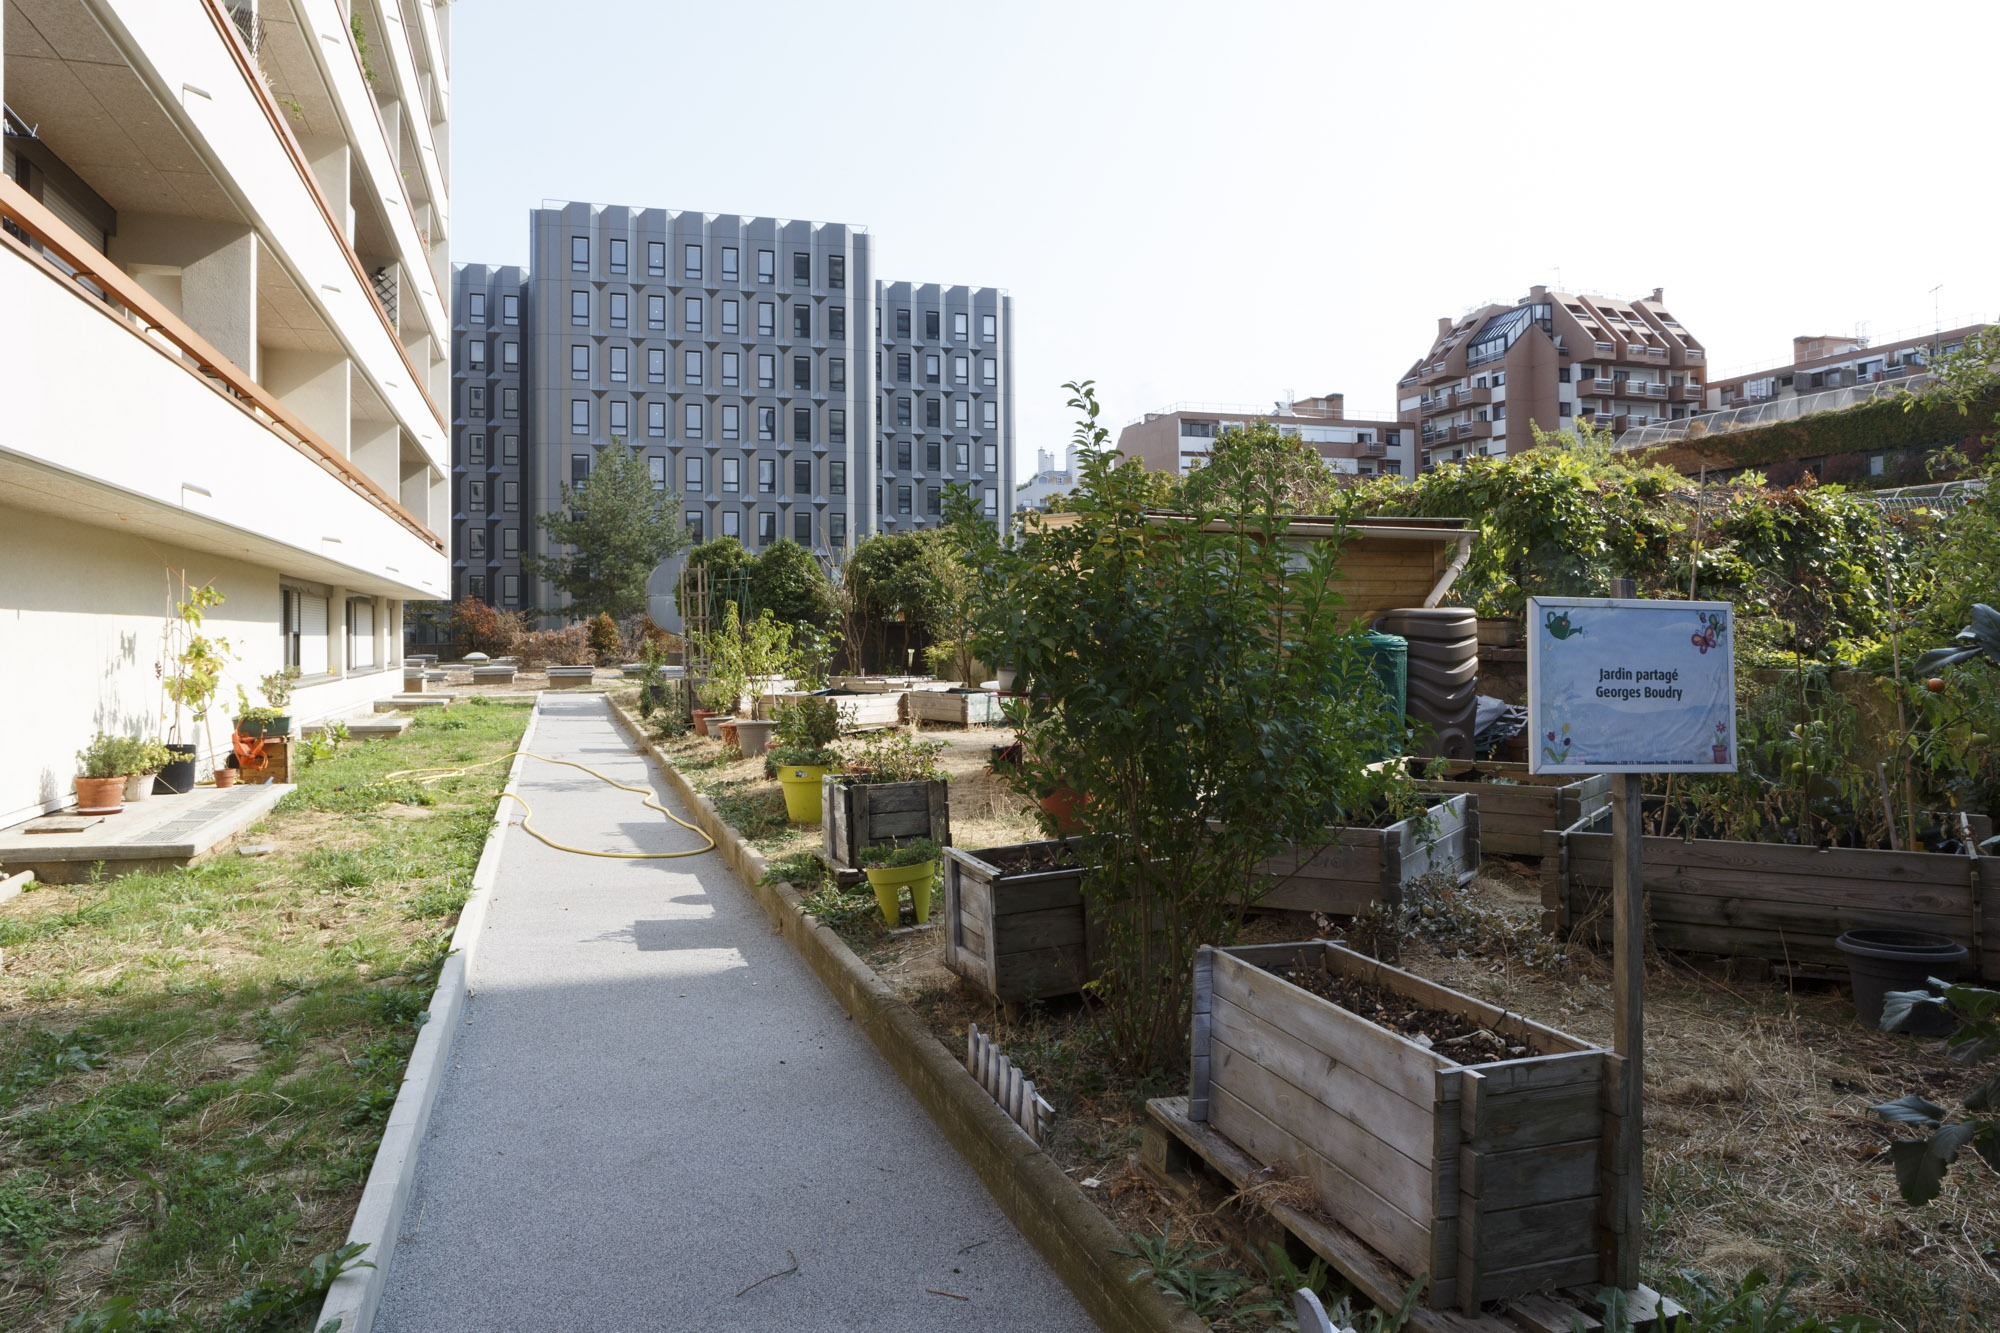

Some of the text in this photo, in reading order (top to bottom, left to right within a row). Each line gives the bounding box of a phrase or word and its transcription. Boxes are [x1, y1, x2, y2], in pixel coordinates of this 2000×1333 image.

[1599, 667, 1679, 684] Jardin partagé
[1596, 685, 1683, 701] Georges Boudry
